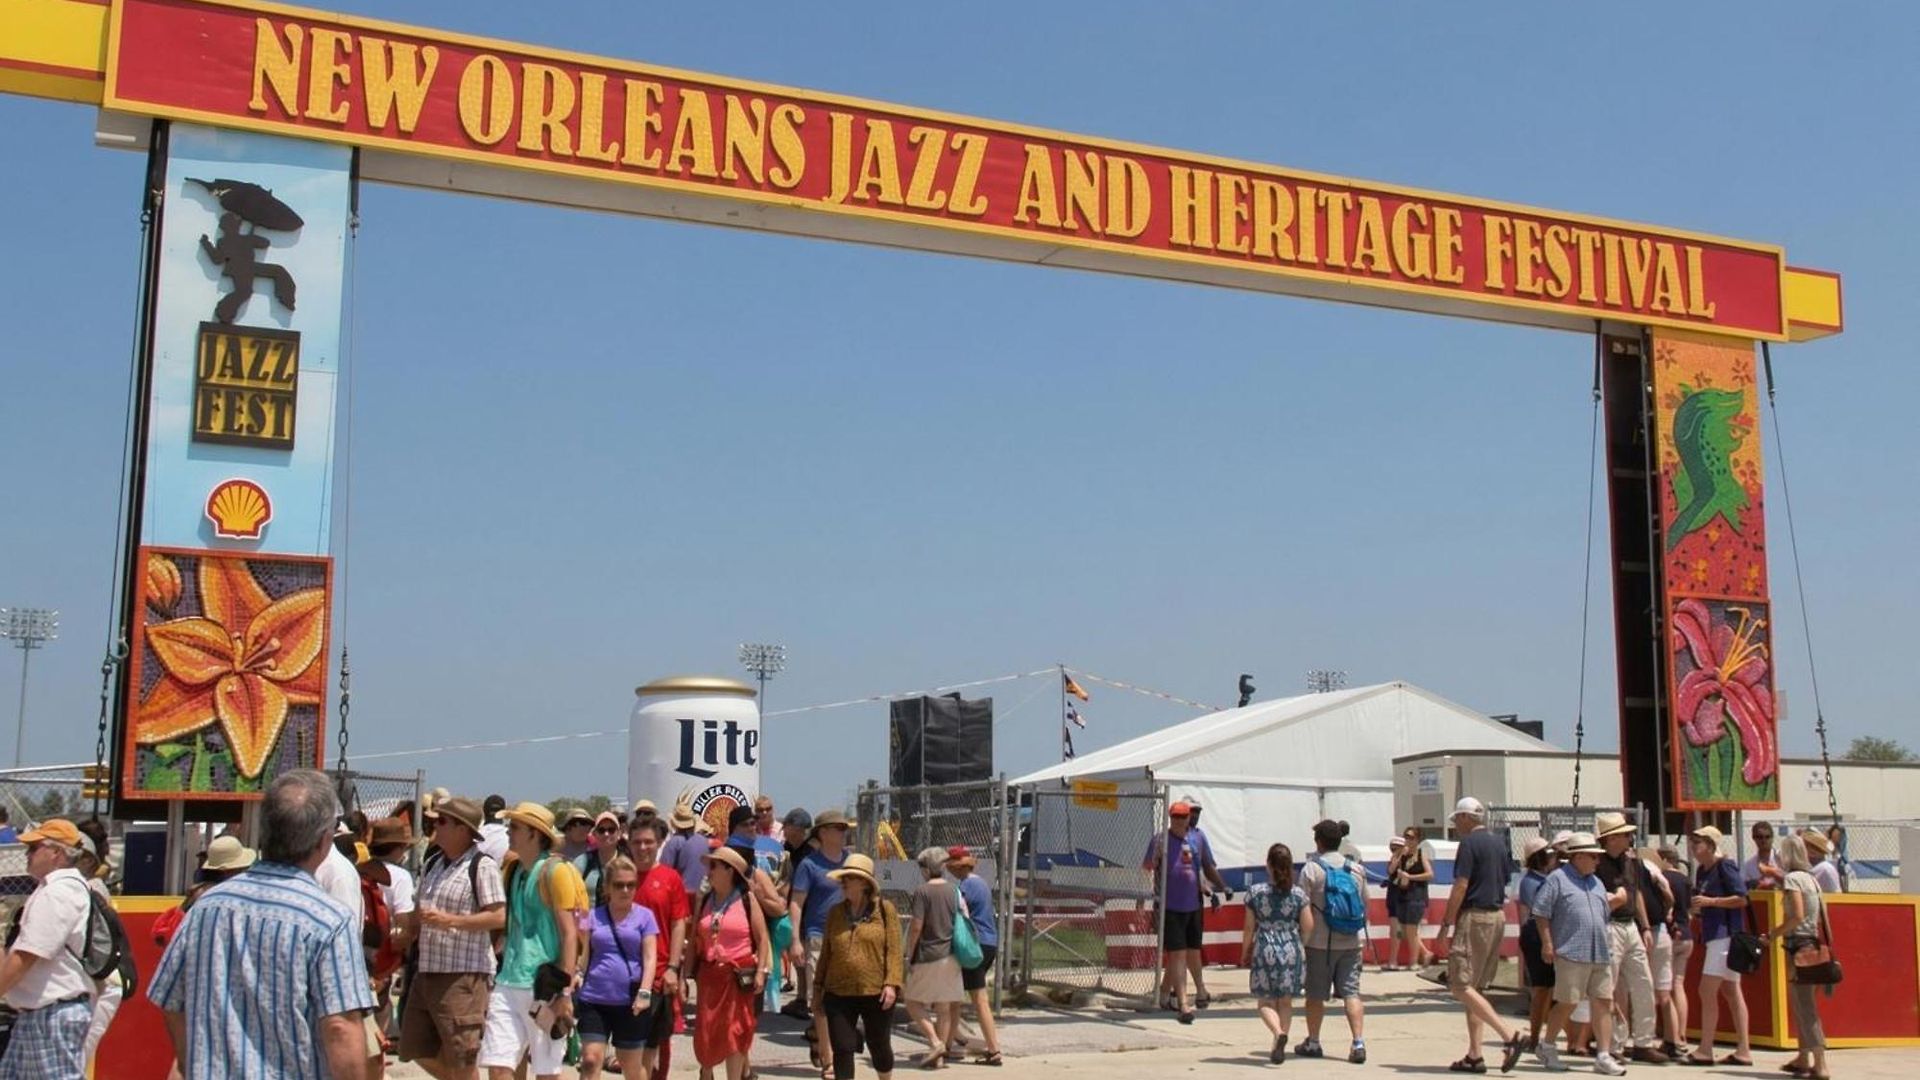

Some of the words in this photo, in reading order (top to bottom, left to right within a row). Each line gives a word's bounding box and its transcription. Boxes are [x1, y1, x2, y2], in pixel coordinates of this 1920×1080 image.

[249, 18, 440, 133] NEW
[458, 53, 806, 189] ORLEANS
[822, 111, 989, 216] JAZZ
[1013, 144, 1151, 237] AND
[1169, 165, 1465, 285] HERITAGE
[1483, 214, 1716, 320] FESTIVAL
[200, 333, 297, 384] JAZZ
[197, 387, 293, 437] FEST
[675, 719, 758, 779] Lite
